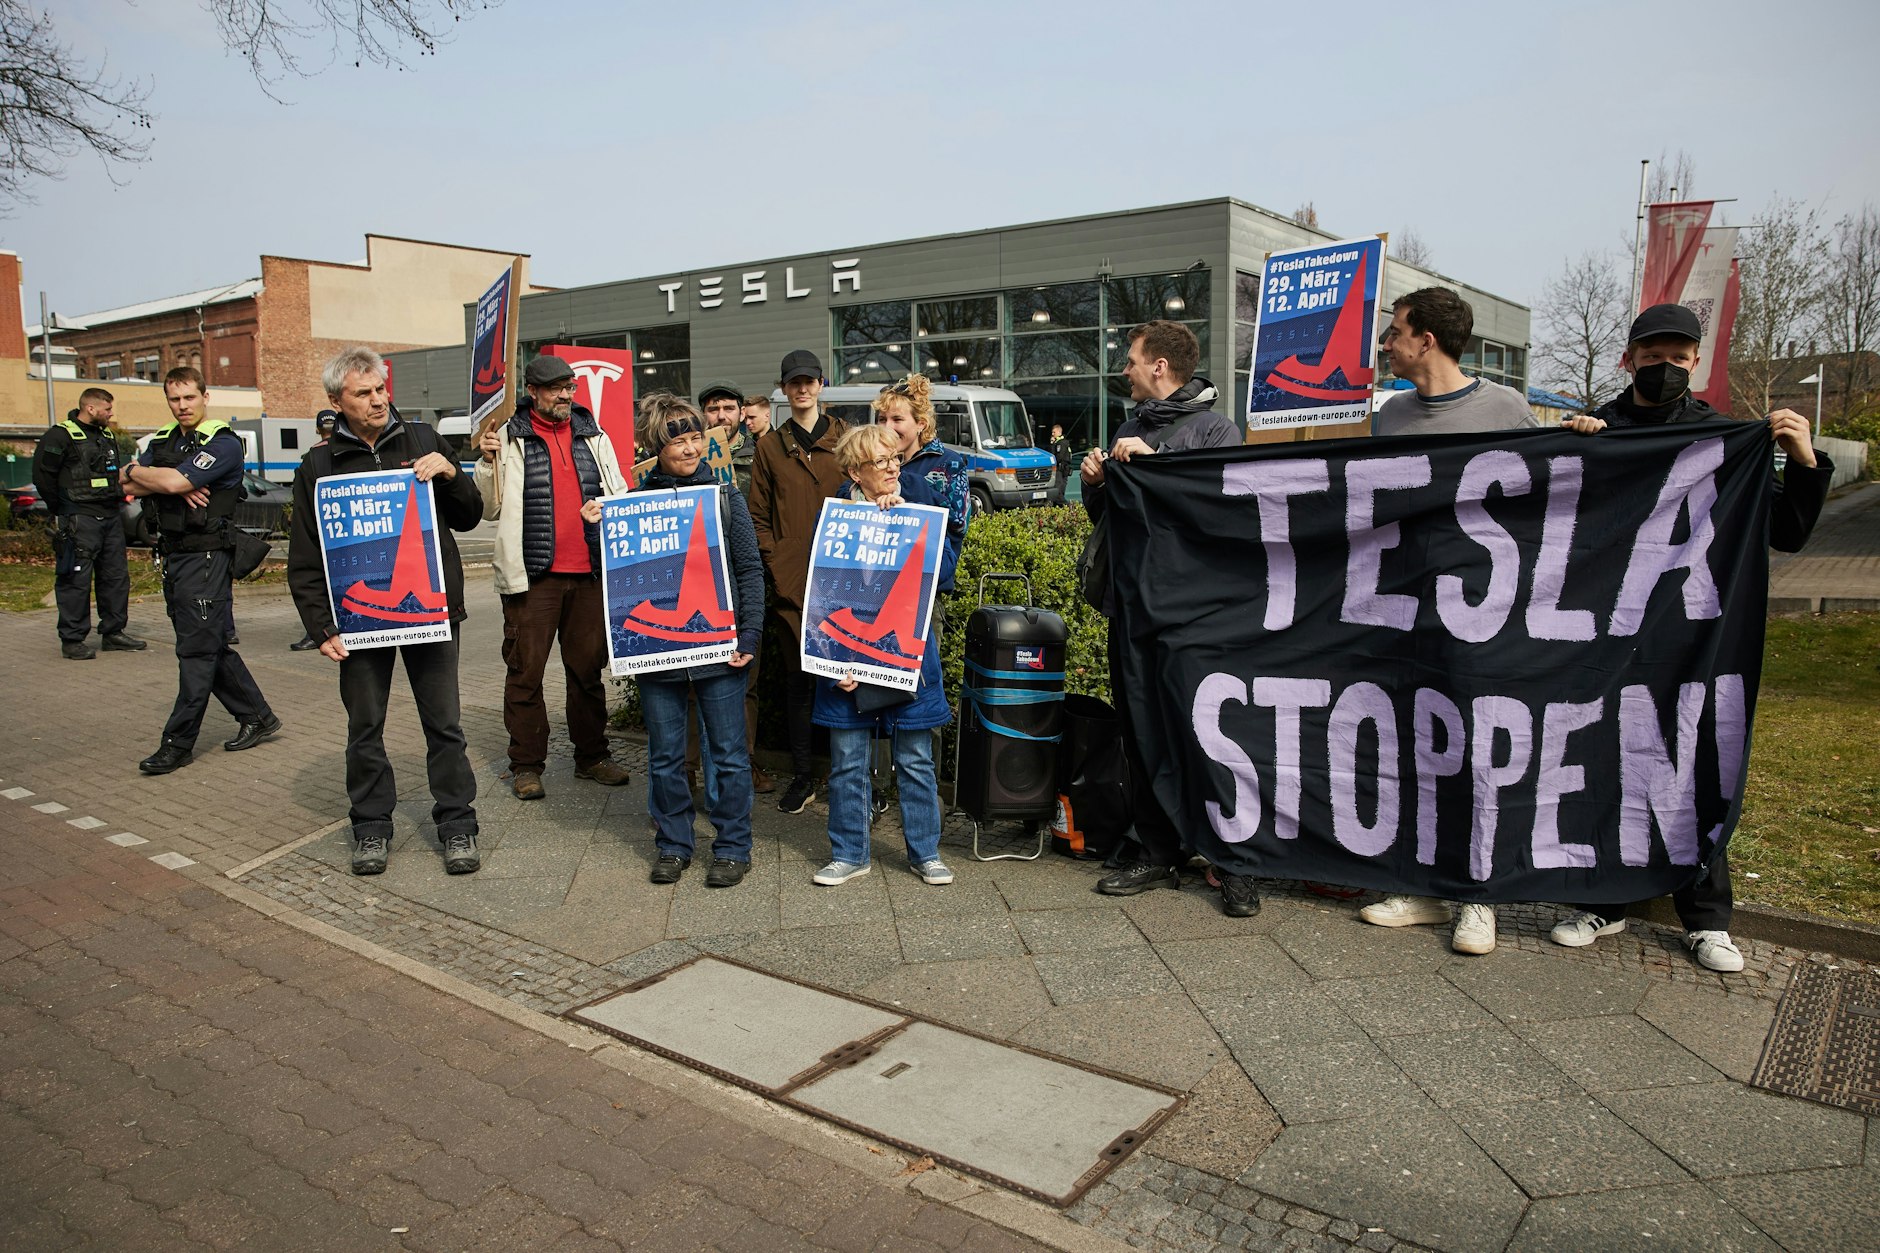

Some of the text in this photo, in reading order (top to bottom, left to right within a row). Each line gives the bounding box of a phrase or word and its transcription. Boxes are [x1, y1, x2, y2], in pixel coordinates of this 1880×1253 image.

[1270, 250, 1359, 273] #TeslaTakedown
[658, 258, 860, 312] TESLA
[1267, 276, 1294, 295] 29.
[1300, 270, 1340, 290] März
[1267, 287, 1338, 313] 12. April
[1265, 324, 1325, 342] TESLA
[1262, 409, 1366, 425] teslatakedown-europe.org
[320, 481, 406, 499] #TeslaTakedown
[322, 502, 346, 520] 29.
[350, 499, 391, 517] März
[605, 498, 694, 519] #TeslaTakedown
[830, 508, 920, 527] #TeslaTakedown
[326, 516, 393, 539] 12. April
[607, 521, 634, 540] 29.
[639, 516, 678, 535] März
[825, 522, 853, 540] 29.
[859, 525, 900, 546] März
[609, 533, 680, 559] 12. April
[1222, 437, 1725, 643] TESLA
[331, 551, 387, 568] TESLA
[823, 539, 897, 567] 12. April
[614, 569, 675, 588] TESLA
[344, 629, 447, 646] teslatakedown-europe.org
[1192, 672, 1746, 881] STOPPEN!
